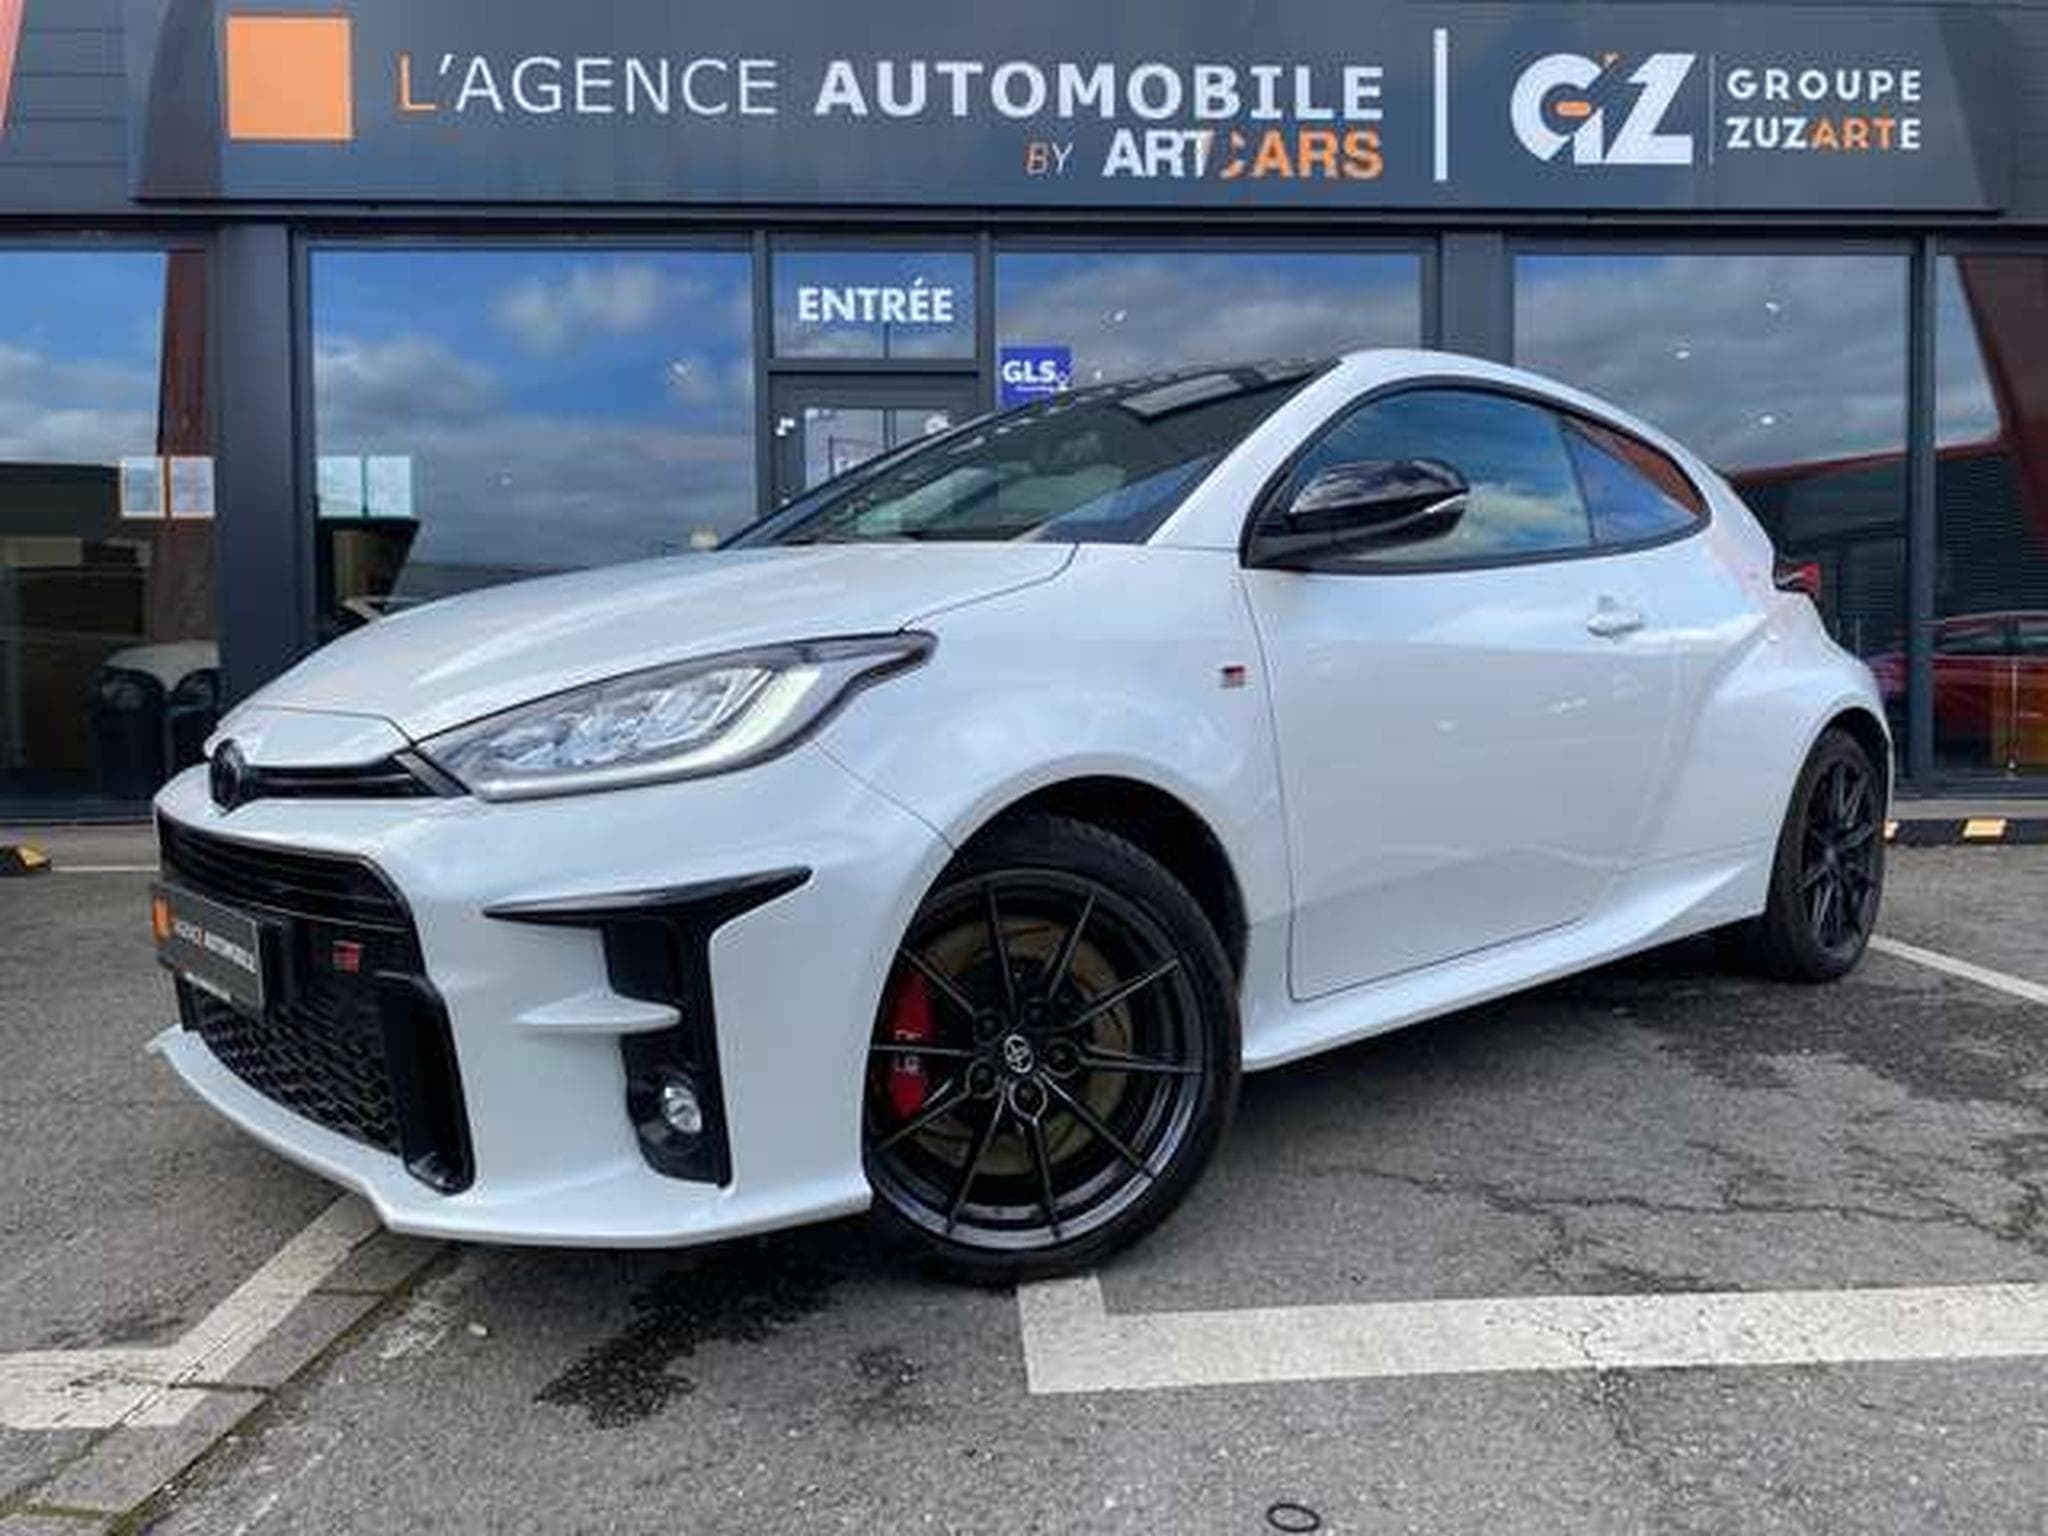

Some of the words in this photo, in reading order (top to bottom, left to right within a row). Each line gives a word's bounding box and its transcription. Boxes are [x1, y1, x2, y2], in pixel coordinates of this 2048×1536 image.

[399, 53, 778, 115] L'AGENCE
[814, 60, 1384, 120] AUTOMOBILE
[1726, 69, 1921, 101] GROUPE
[1725, 117, 1921, 149] ZUZARTE
[1024, 142, 1073, 175] BY
[798, 277, 954, 323] ENTRÉE
